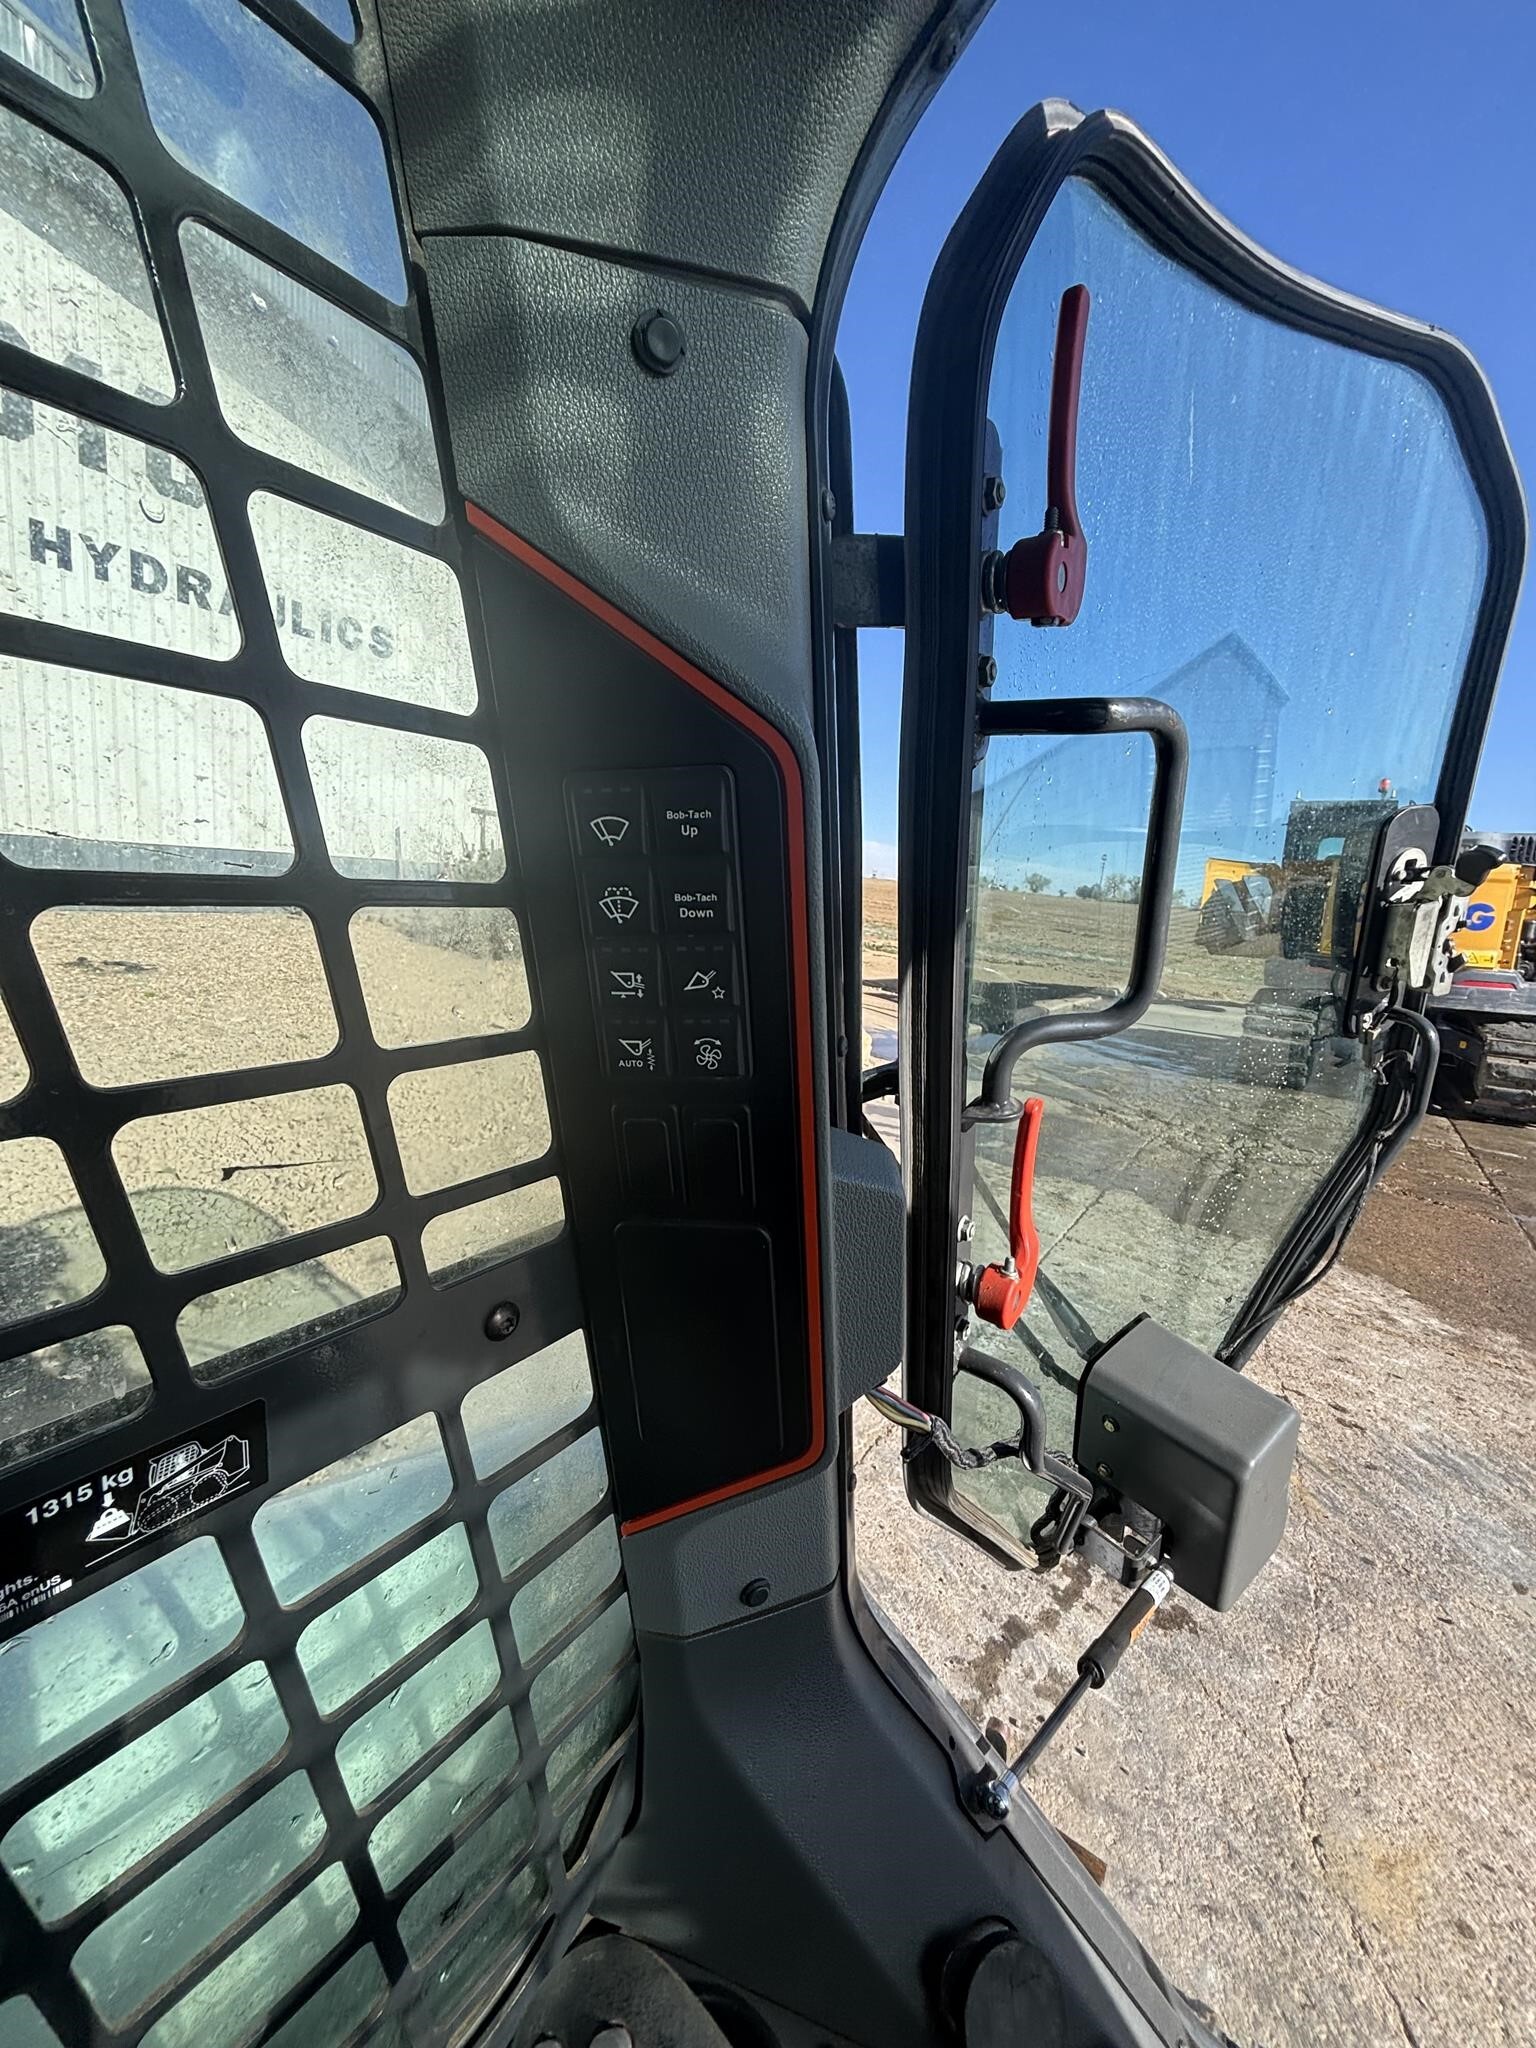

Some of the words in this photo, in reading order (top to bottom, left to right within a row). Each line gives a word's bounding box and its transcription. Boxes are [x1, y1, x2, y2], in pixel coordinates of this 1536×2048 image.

[666, 809, 712, 820] Bob-Tach
[681, 824, 698, 838] Up
[674, 893, 718, 902] Bob-Tach
[679, 907, 714, 918] Down
[618, 1059, 644, 1068] AUTO
[25, 1482, 93, 1525] 1315
[101, 1466, 134, 1492] kg
[21, 1574, 62, 1601] enUS
